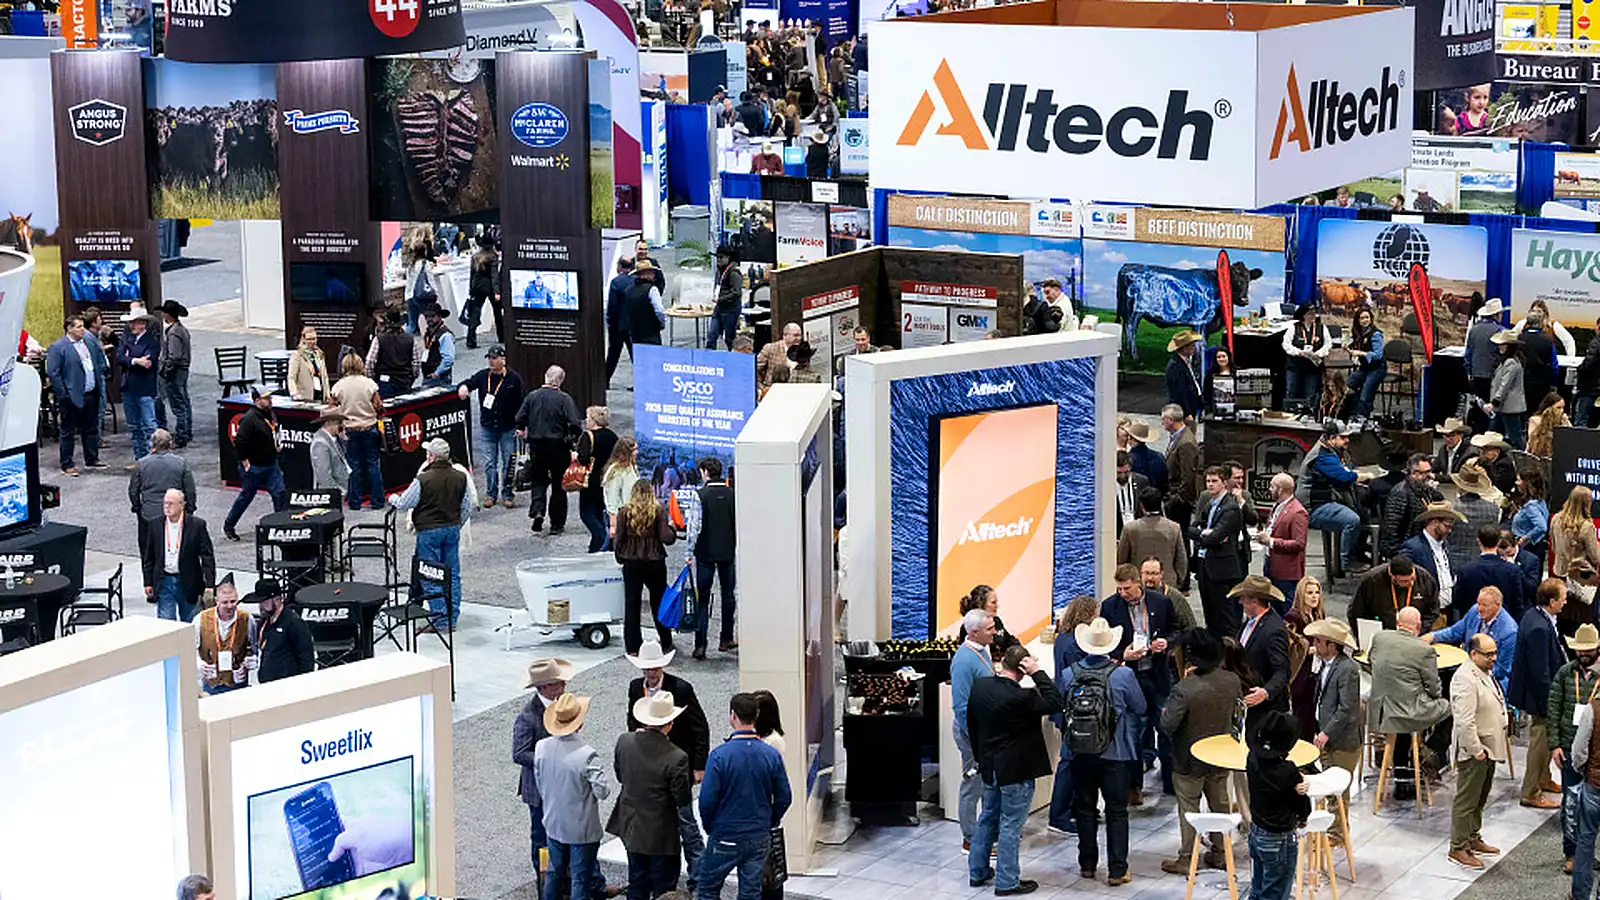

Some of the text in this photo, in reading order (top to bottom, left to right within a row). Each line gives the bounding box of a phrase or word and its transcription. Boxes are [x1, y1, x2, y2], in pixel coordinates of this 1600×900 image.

[1446, 43, 1461, 57] THE
[1504, 58, 1578, 80] Bureau
[79, 109, 117, 119] ANGUS
[1486, 91, 1578, 135] Education
[76, 119, 121, 130] STRONG
[511, 155, 554, 168] Walmart
[915, 205, 1018, 227] CALF DISTINCTION
[1148, 219, 1175, 235] BEEF
[1177, 221, 1254, 241] DISTINCTION
[904, 313, 912, 332] 2
[672, 376, 714, 396] Sysco
[967, 380, 1015, 397] Alltech
[400, 422, 422, 444] 44
[425, 410, 465, 430] FARMS
[1565, 472, 1586, 484] WITH
[290, 493, 331, 506] LAIRD
[267, 528, 312, 541] LAIRD
[958, 516, 1034, 545] Alltech
[0, 554, 34, 567] AIRD
[301, 608, 349, 622] LAIRD
[300, 728, 373, 765] Sweetlix
